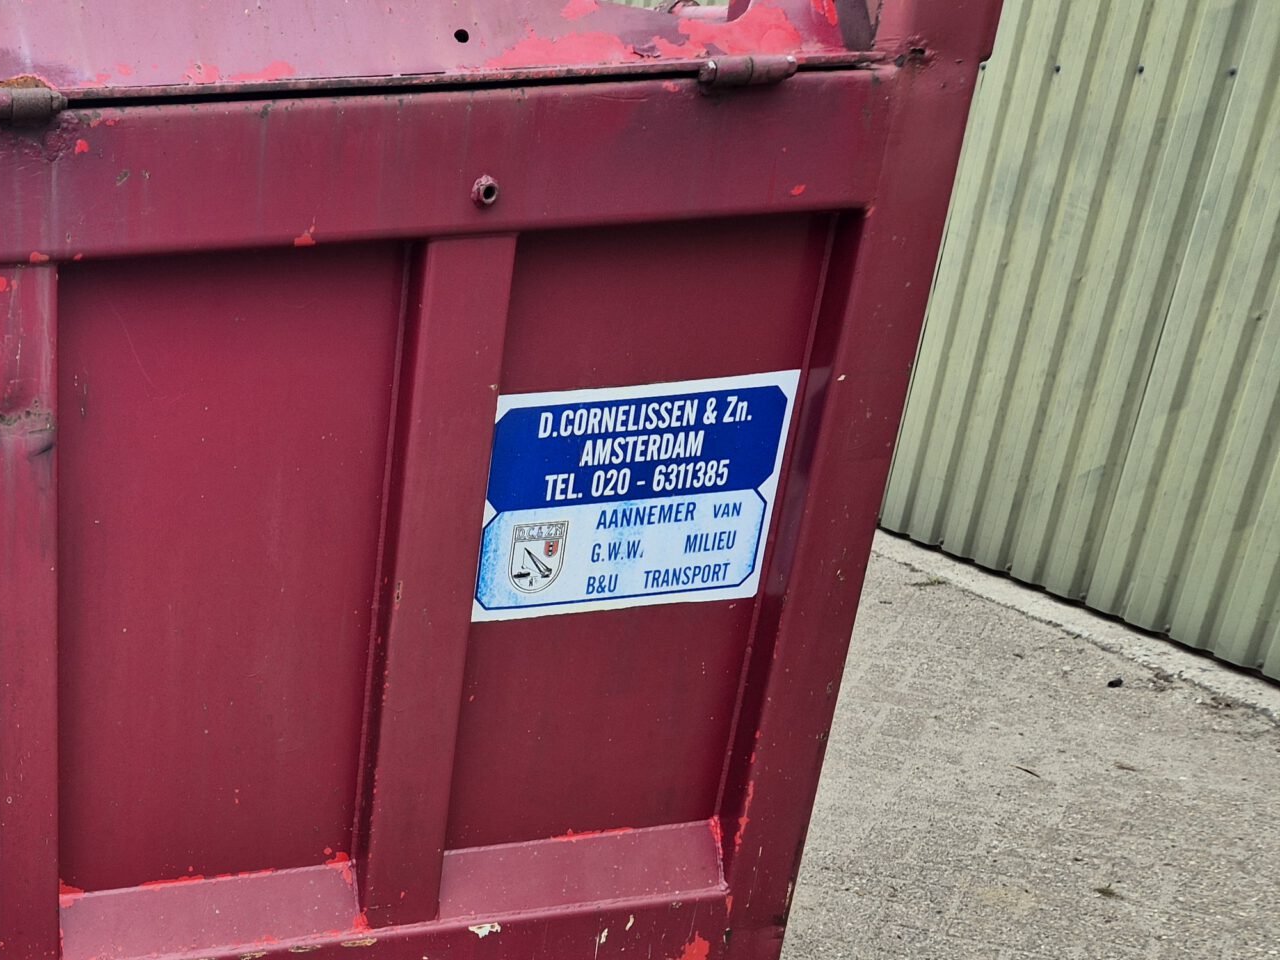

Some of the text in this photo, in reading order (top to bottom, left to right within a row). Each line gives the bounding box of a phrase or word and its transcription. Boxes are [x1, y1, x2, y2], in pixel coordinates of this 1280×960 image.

[538, 396, 752, 439] D.CORNELISSEN & Zn.
[579, 431, 704, 467] AMSTERDAM
[545, 473, 582, 501] TEL.
[592, 468, 630, 497] 020
[652, 460, 729, 492] 6311385
[596, 502, 742, 530] AANNEMER VAN
[591, 530, 736, 563] G.W.W. MILIEU
[586, 563, 730, 595] B&U TRANSPORT
